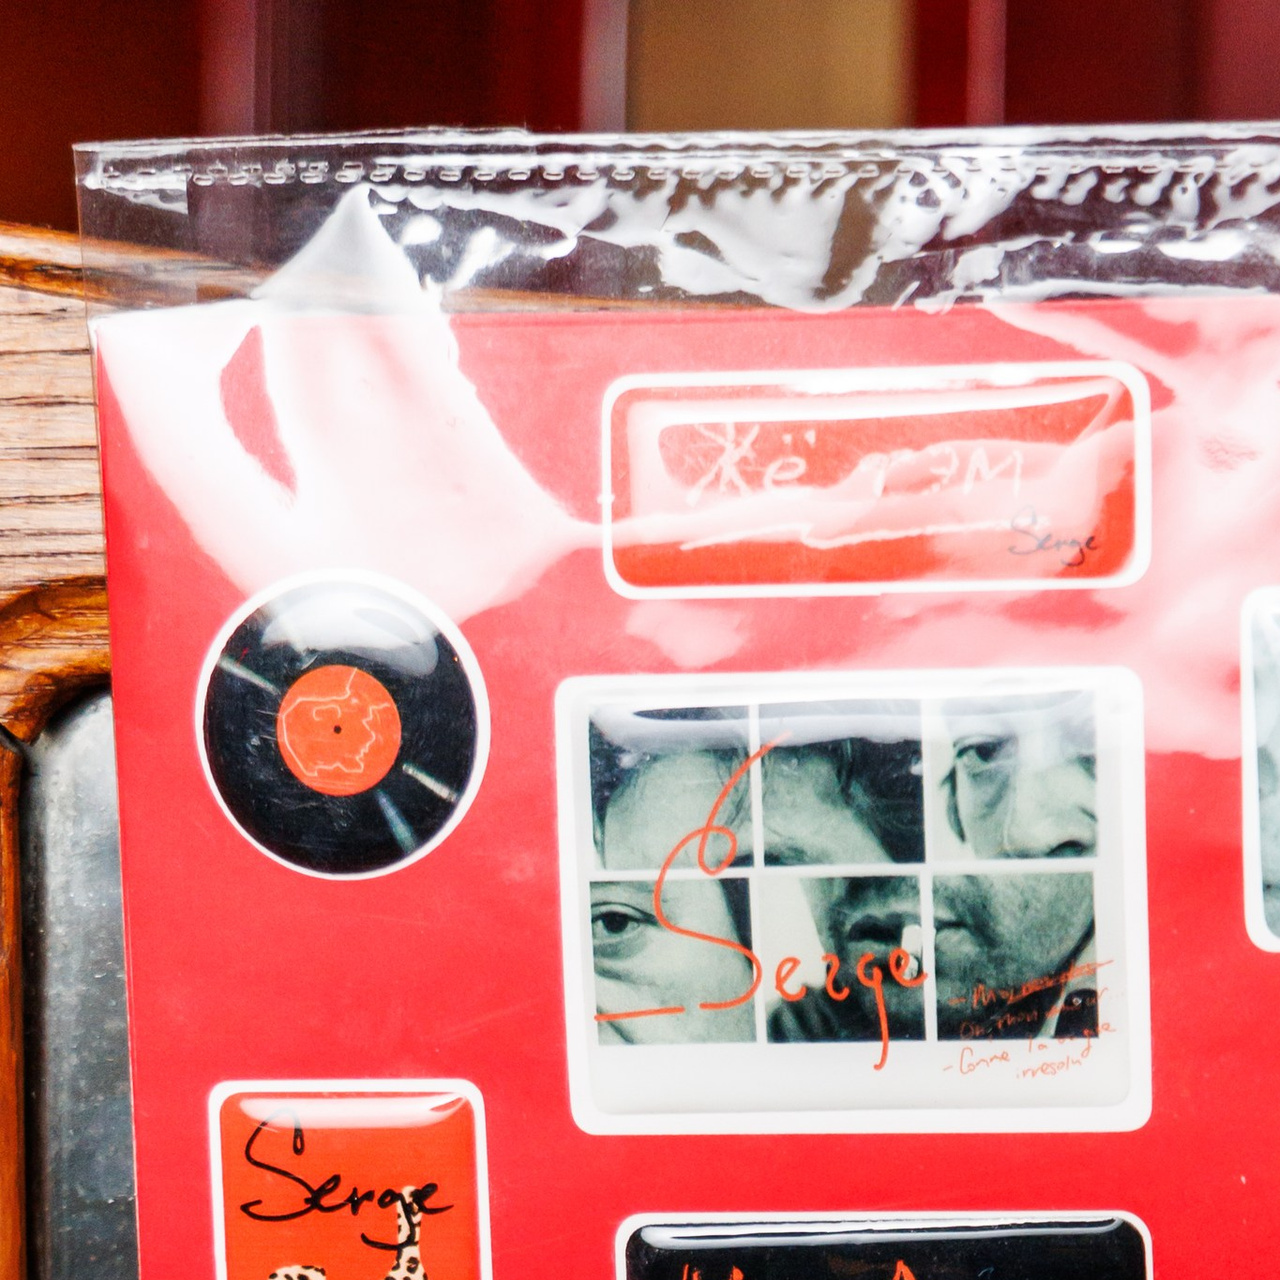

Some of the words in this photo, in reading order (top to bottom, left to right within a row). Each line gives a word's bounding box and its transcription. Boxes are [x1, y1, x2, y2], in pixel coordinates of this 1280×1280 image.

[1007, 505, 1099, 567] Serge
[654, 730, 930, 1070] Serge
[240, 1107, 454, 1250] Serge
